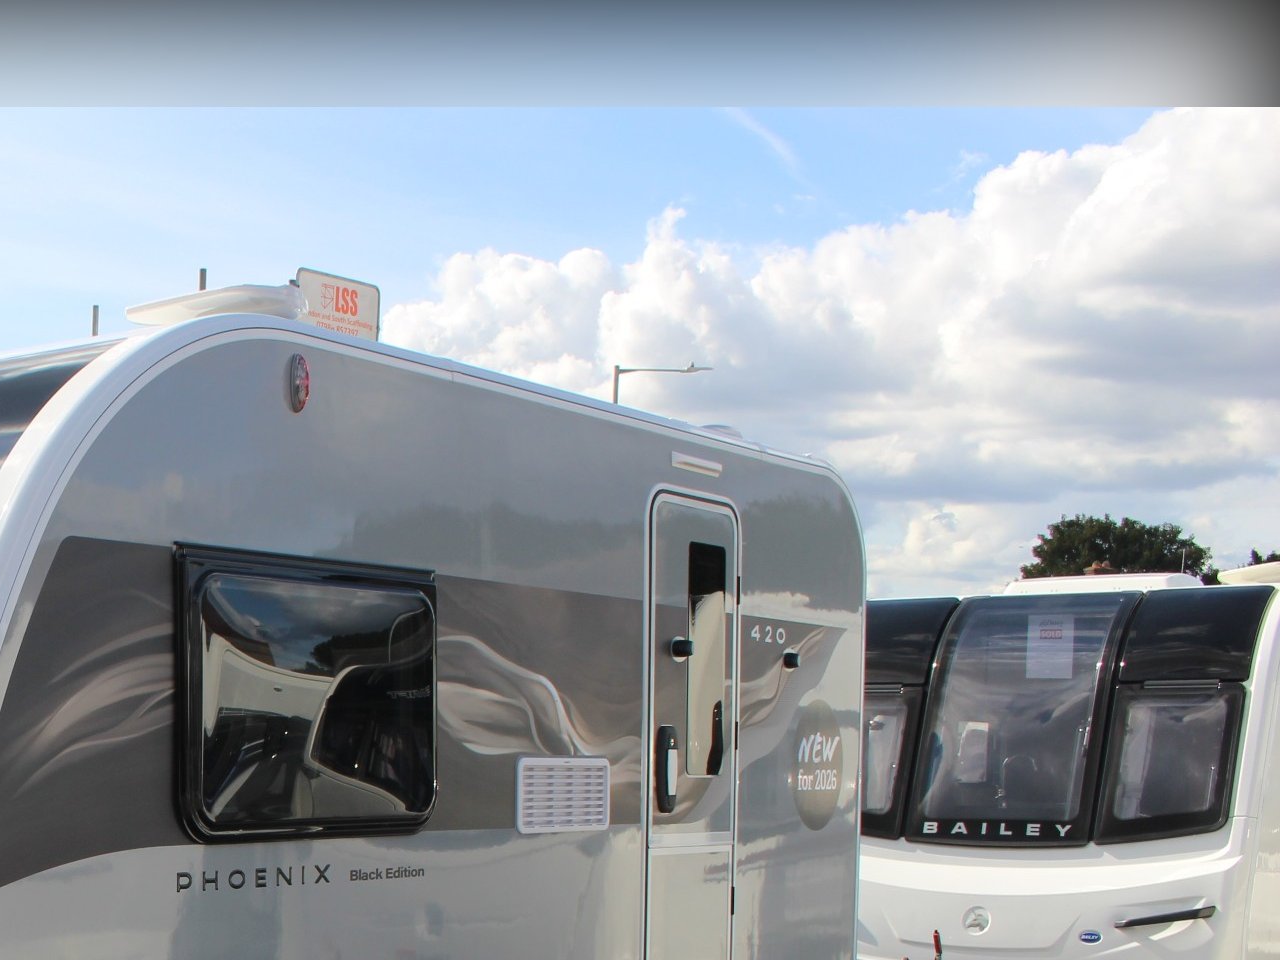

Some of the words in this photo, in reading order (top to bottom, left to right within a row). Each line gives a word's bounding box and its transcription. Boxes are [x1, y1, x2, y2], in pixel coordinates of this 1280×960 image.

[334, 286, 358, 317] LSS
[750, 624, 787, 645] 420
[1040, 630, 1062, 639] SOLD
[798, 731, 840, 764] NEW
[797, 769, 814, 791] for
[814, 769, 838, 791] 2026
[922, 820, 1073, 838] BAILEY
[176, 864, 331, 892] PHOENIX
[349, 868, 383, 882] Black
[385, 866, 425, 880] Edition
